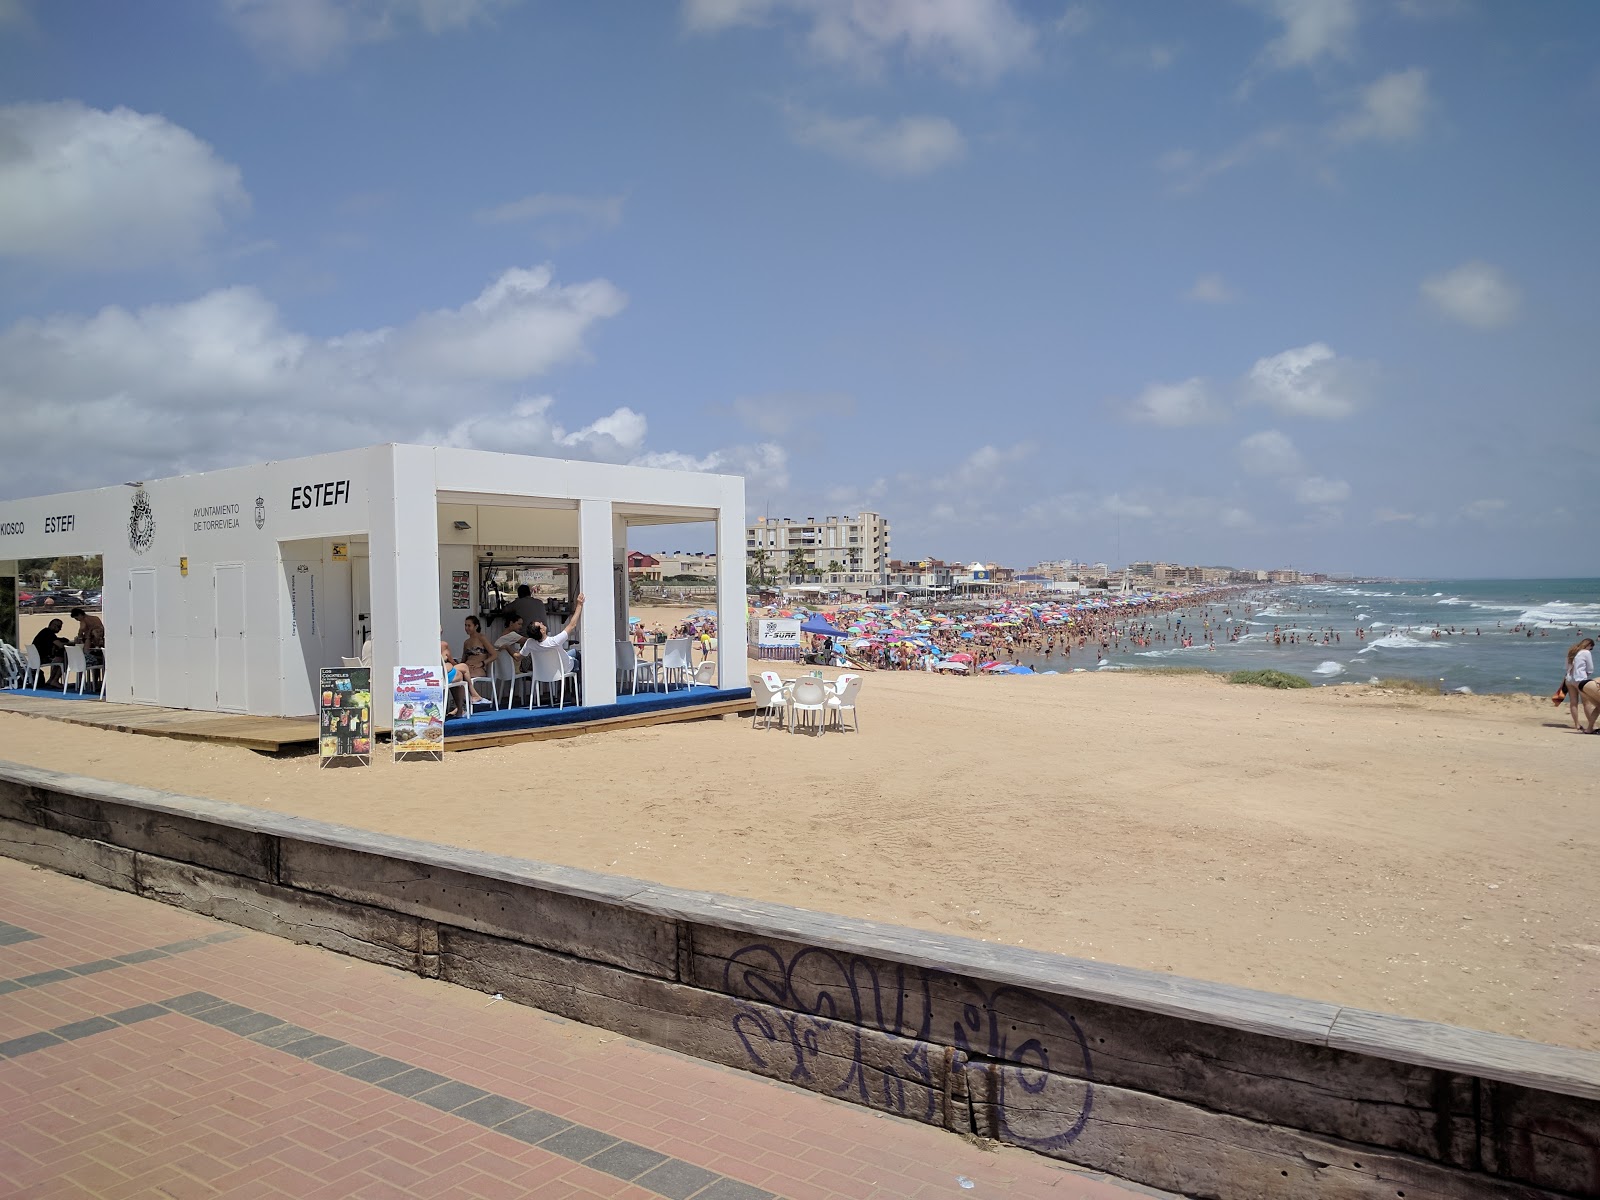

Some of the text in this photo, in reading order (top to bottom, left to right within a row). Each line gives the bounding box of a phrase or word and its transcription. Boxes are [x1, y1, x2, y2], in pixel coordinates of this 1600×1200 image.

[291, 480, 350, 510] ESTEFI
[193, 503, 240, 518] AYUNTAMIENTO
[0, 514, 75, 536] KIOSCO ESTEFI
[193, 518, 240, 532] DE TORREVIEJA
